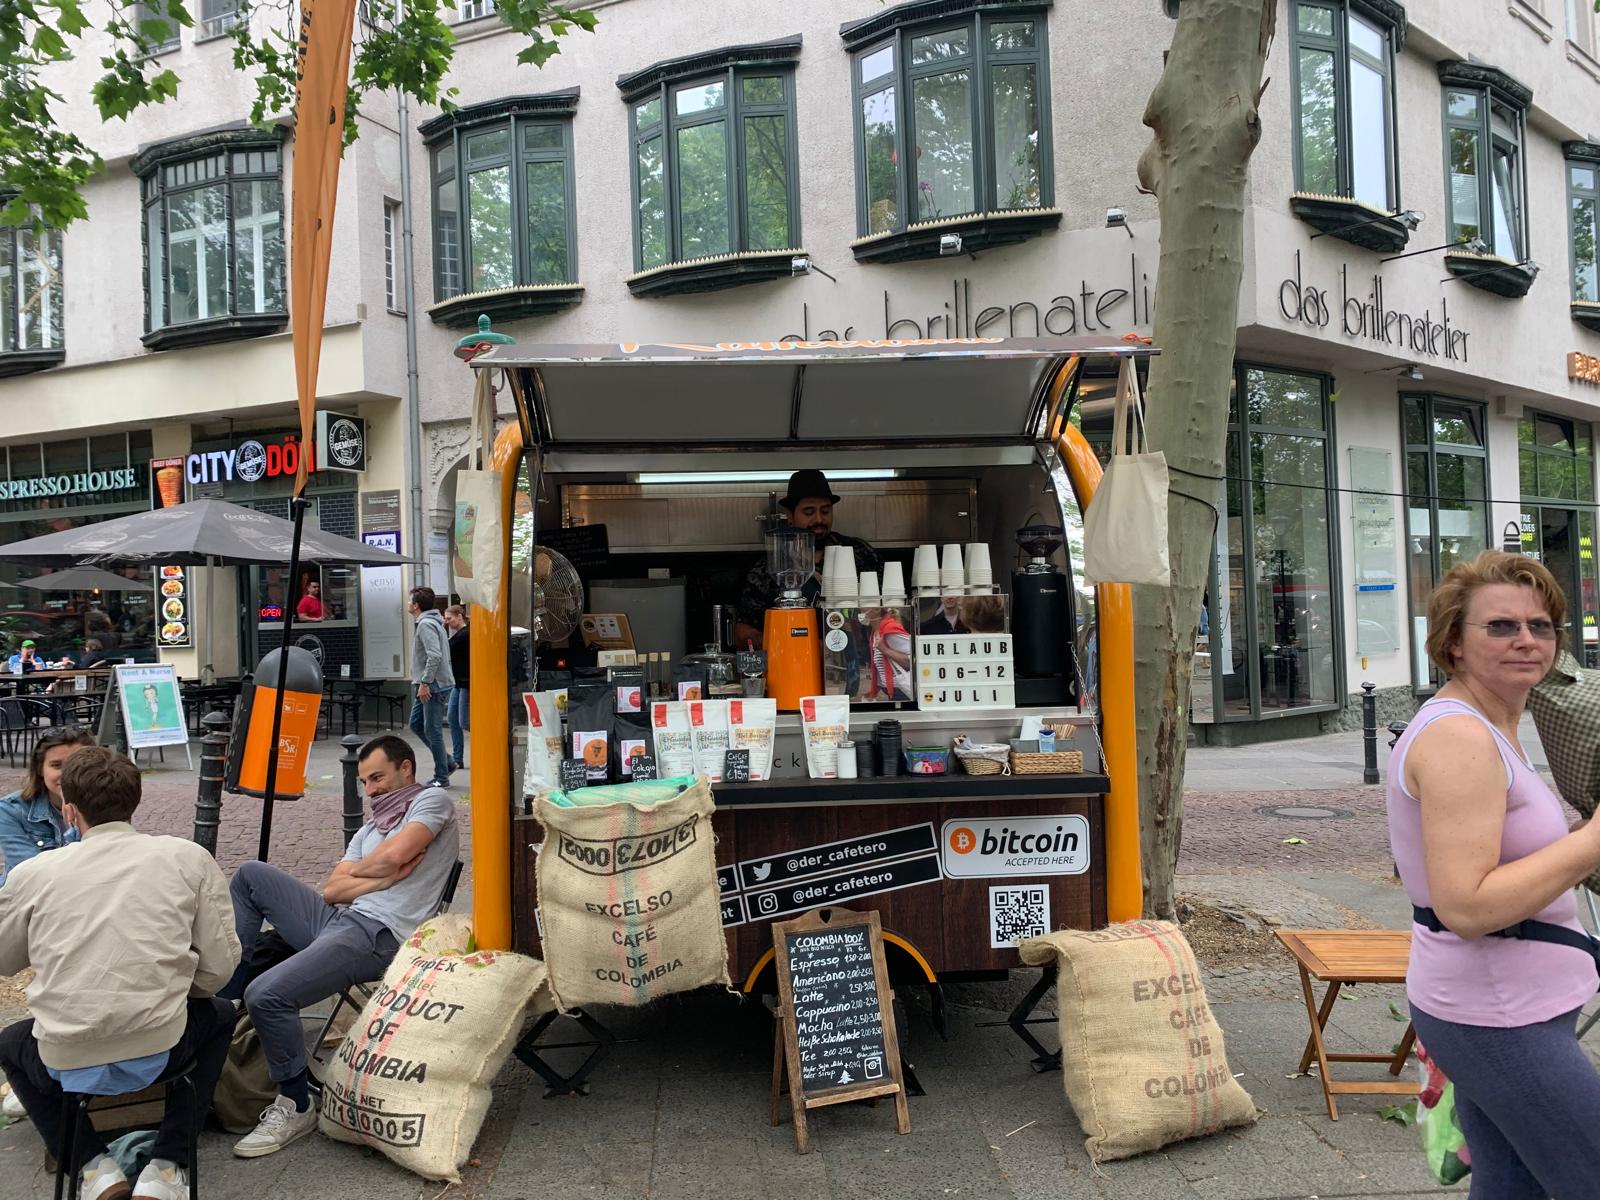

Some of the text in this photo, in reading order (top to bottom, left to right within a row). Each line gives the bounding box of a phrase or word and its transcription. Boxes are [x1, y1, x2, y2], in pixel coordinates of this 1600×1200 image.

[885, 253, 1149, 339] brillenateli
[1280, 249, 1471, 363] das brillenatelier
[186, 449, 237, 485] CITY
[0, 468, 136, 499] SPRESSO HOUSE
[261, 607, 283, 618] OPEN
[923, 641, 1008, 656] URLAUB
[938, 690, 997, 703] JULI
[980, 826, 1079, 855] bitcoin
[786, 841, 887, 872] @der_cafetero
[1004, 855, 1075, 867] ACCEPTED HERE
[792, 870, 893, 903] @der_cafetero
[584, 890, 673, 918] EXCELSO
[612, 924, 657, 948] CAFÉ
[795, 932, 864, 948] COLOMBIA 100%
[626, 953, 649, 969] DE
[790, 957, 840, 973] Espresso
[595, 958, 683, 989] COLOMBIA
[793, 971, 846, 987] Americano
[372, 983, 465, 1025] PRODUCT
[793, 991, 824, 1004] Latte
[796, 1003, 851, 1022] Cappuccino
[367, 1017, 401, 1043] OF
[797, 1018, 833, 1035] Mocha
[820, 1029, 860, 1044] Schokolade
[800, 1050, 817, 1062] Tee
[1189, 1035, 1212, 1058] DE
[339, 1036, 428, 1084] COLOMBIA
[361, 1094, 386, 1109] NET
